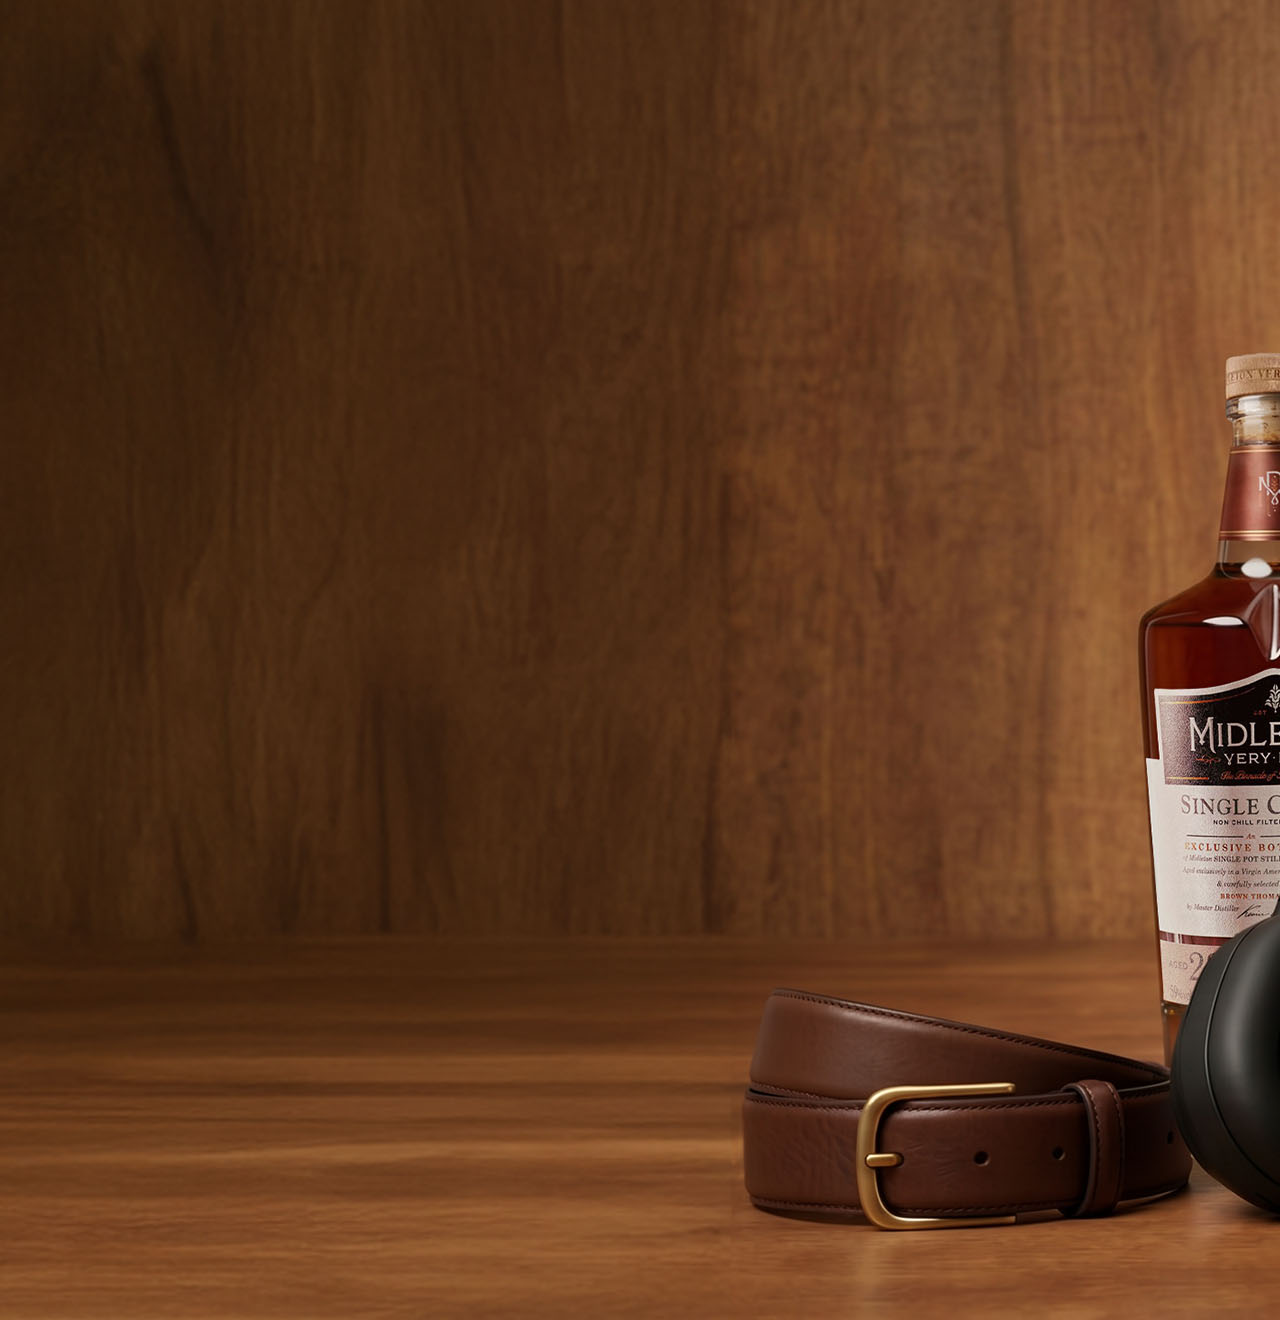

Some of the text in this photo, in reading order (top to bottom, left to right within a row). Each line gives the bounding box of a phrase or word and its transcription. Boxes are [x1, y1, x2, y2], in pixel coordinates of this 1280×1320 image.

[1181, 794, 1259, 816] SINGLE
[1184, 842, 1252, 852] EXCLUSIVE
[1214, 855, 1241, 863] SINGLE
[1243, 855, 1259, 863] POT
[1241, 867, 1262, 876] Virgin
[1216, 880, 1222, 888] &
[1253, 880, 1280, 888] selected
[1194, 904, 1213, 912] Master
[1214, 904, 1240, 912] Distiller
[1168, 960, 1189, 970] AGED
